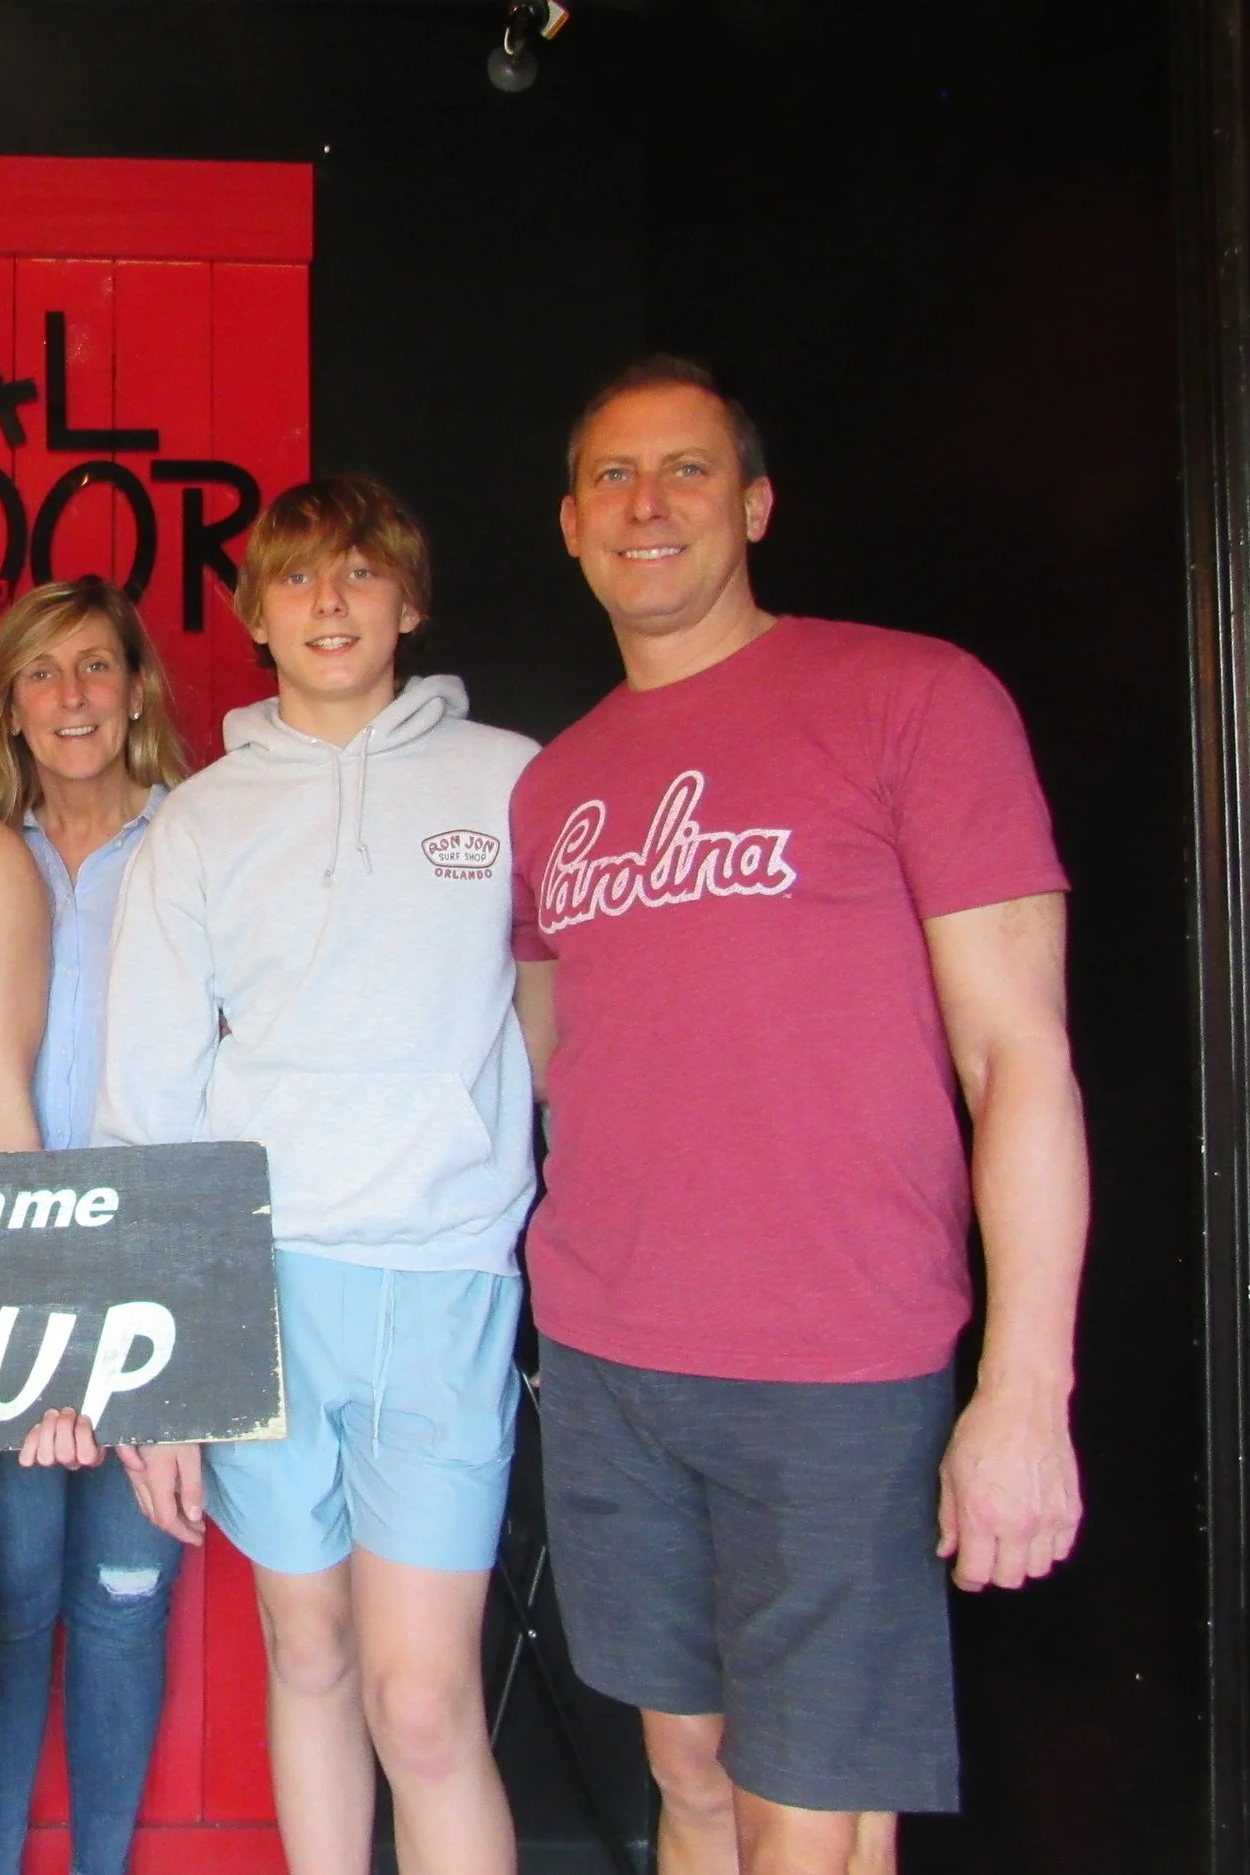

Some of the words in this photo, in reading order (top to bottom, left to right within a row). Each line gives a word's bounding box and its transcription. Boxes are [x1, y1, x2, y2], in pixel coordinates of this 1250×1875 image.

[428, 835, 460, 855] RON
[464, 836, 494, 853] JON
[538, 769, 797, 934] Carolina
[438, 853, 460, 861] SURF
[464, 853, 487, 862] SHOP
[434, 867, 492, 880] ORLANDO
